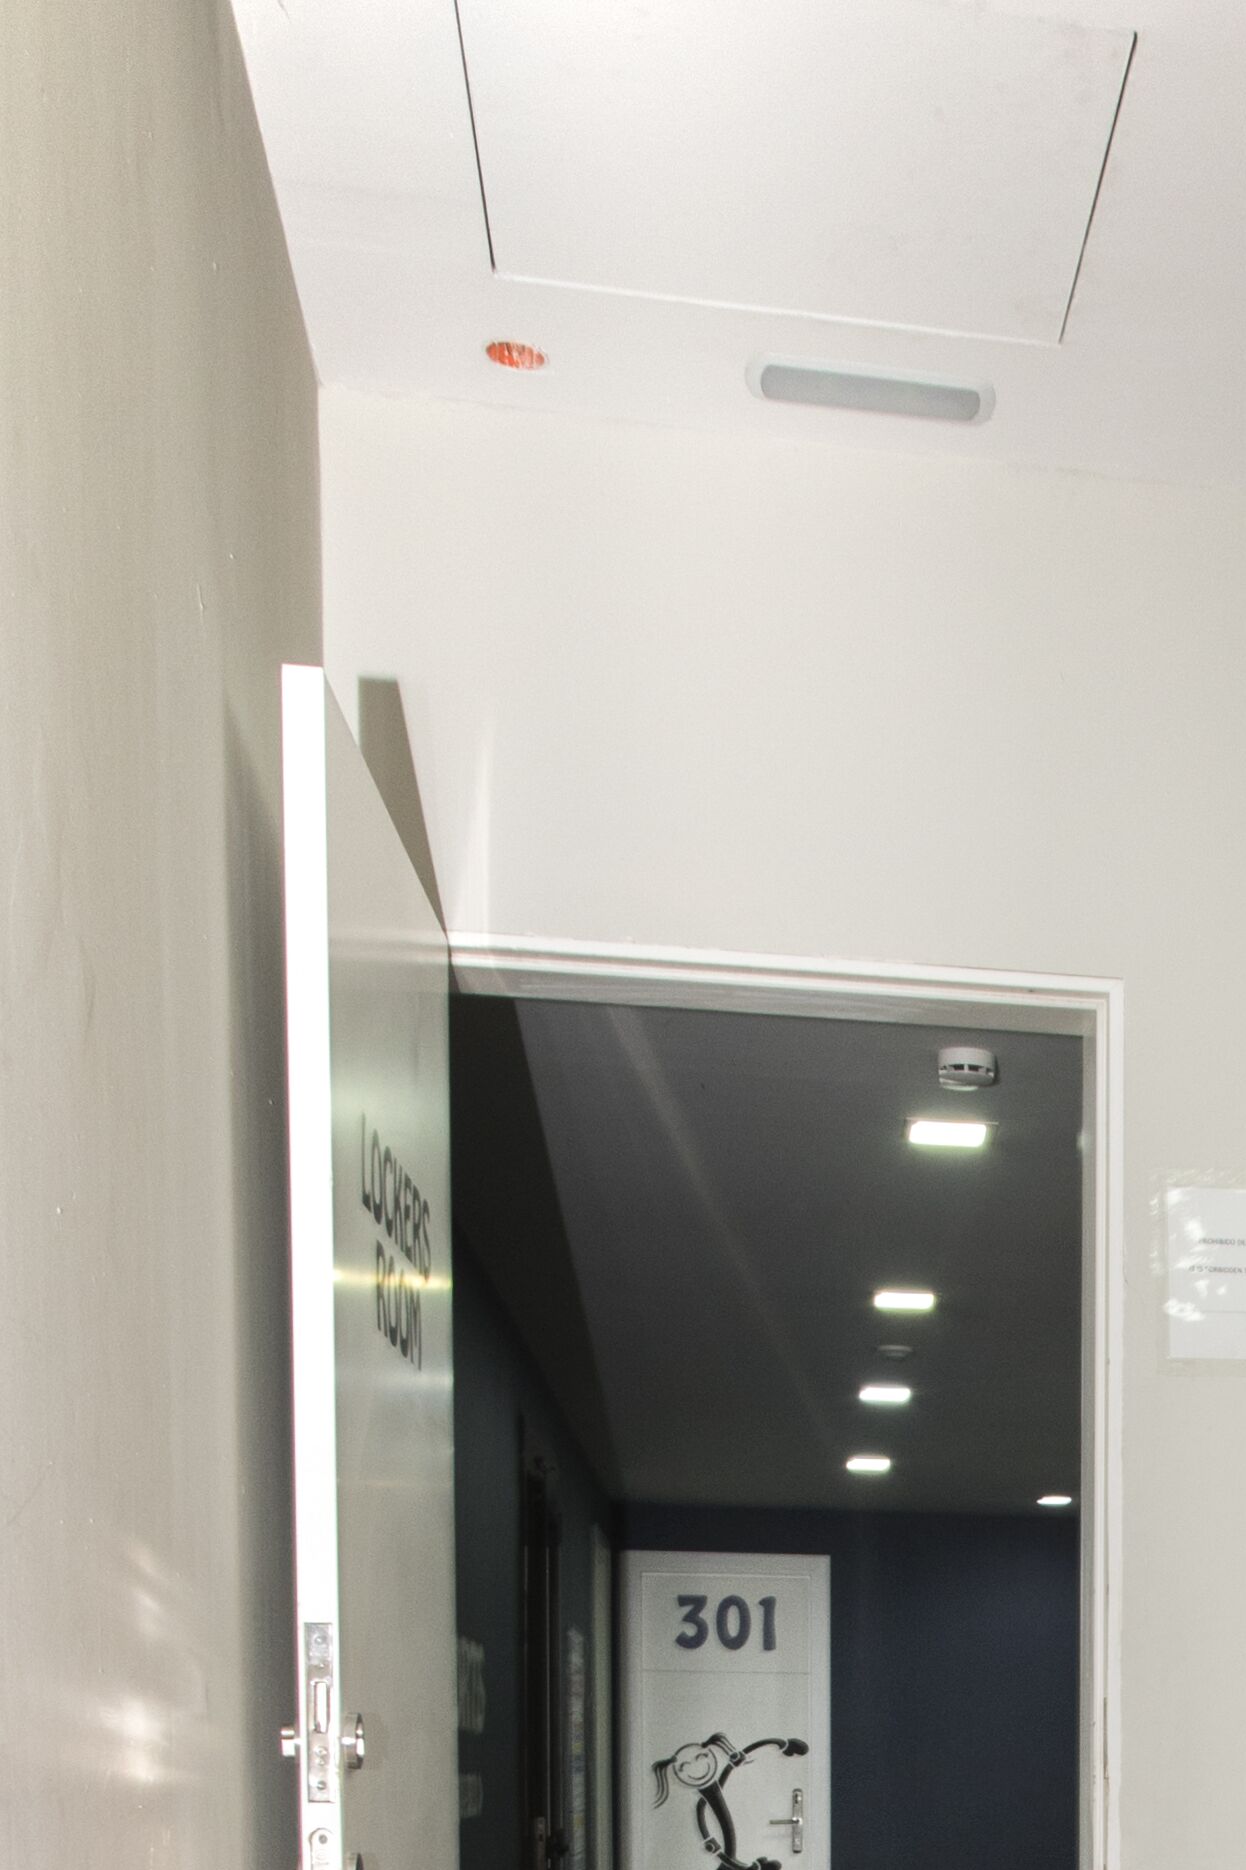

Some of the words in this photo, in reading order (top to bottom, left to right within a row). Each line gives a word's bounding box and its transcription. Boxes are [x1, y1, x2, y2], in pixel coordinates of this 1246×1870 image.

[361, 1112, 431, 1282] LOCKERS
[376, 1238, 422, 1372] ROOM
[674, 1594, 778, 1651] 301
